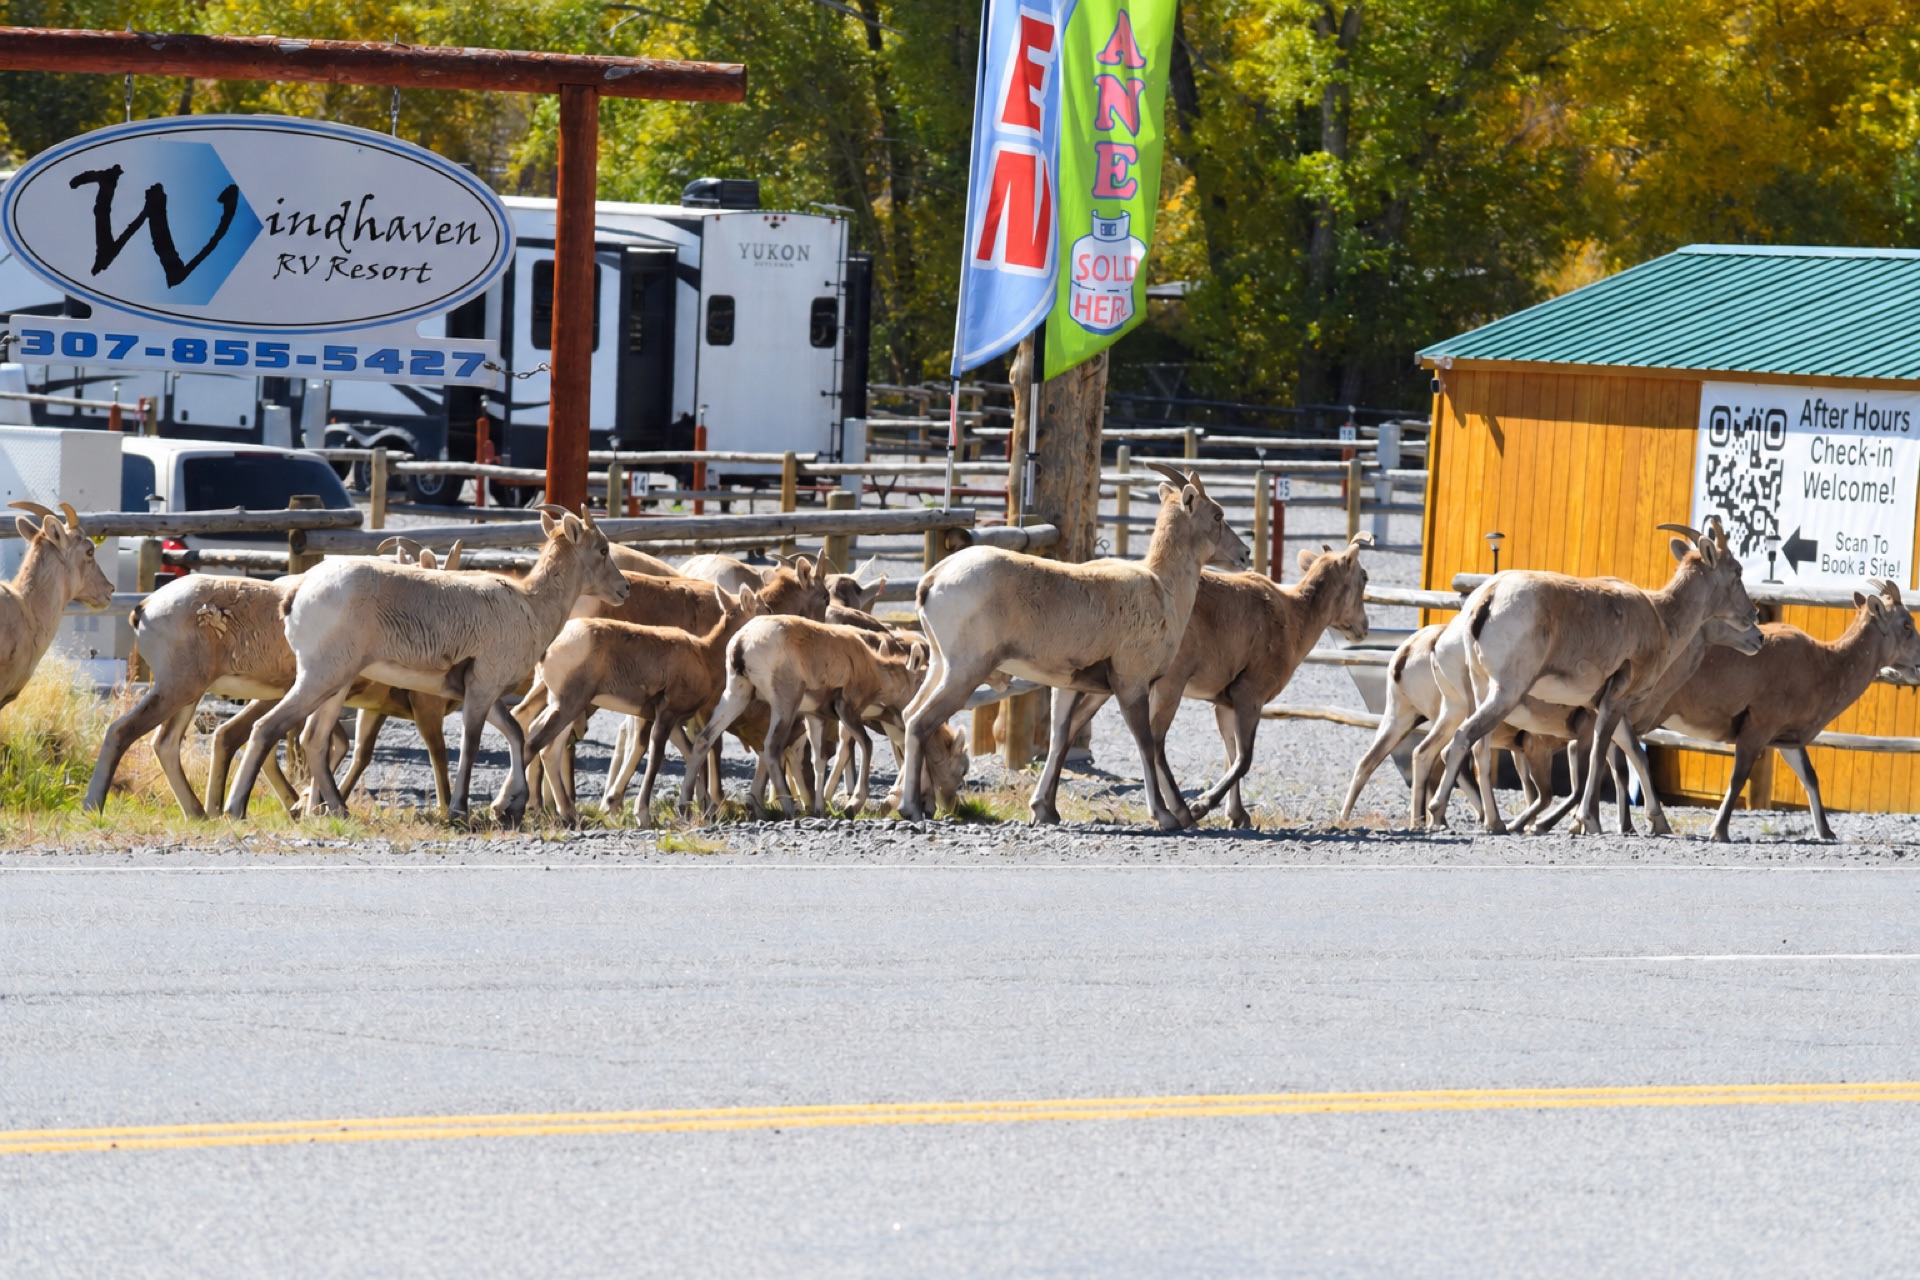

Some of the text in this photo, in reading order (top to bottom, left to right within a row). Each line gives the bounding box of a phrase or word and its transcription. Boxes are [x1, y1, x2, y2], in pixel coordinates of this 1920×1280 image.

[69, 164, 481, 289] Windhaven
[738, 242, 811, 261] YUKON
[273, 253, 433, 284] RV Resort
[1076, 253, 1138, 282] SOLD
[20, 329, 487, 379] 307-855-5427
[1799, 398, 1910, 432] After Hours
[1810, 435, 1893, 468] Check-in
[633, 474, 646, 494] 14
[1279, 480, 1290, 497] 15
[1803, 470, 1896, 504] Welcome!
[1835, 531, 1888, 555] Scan To
[1821, 554, 1900, 578] Book a Site!
